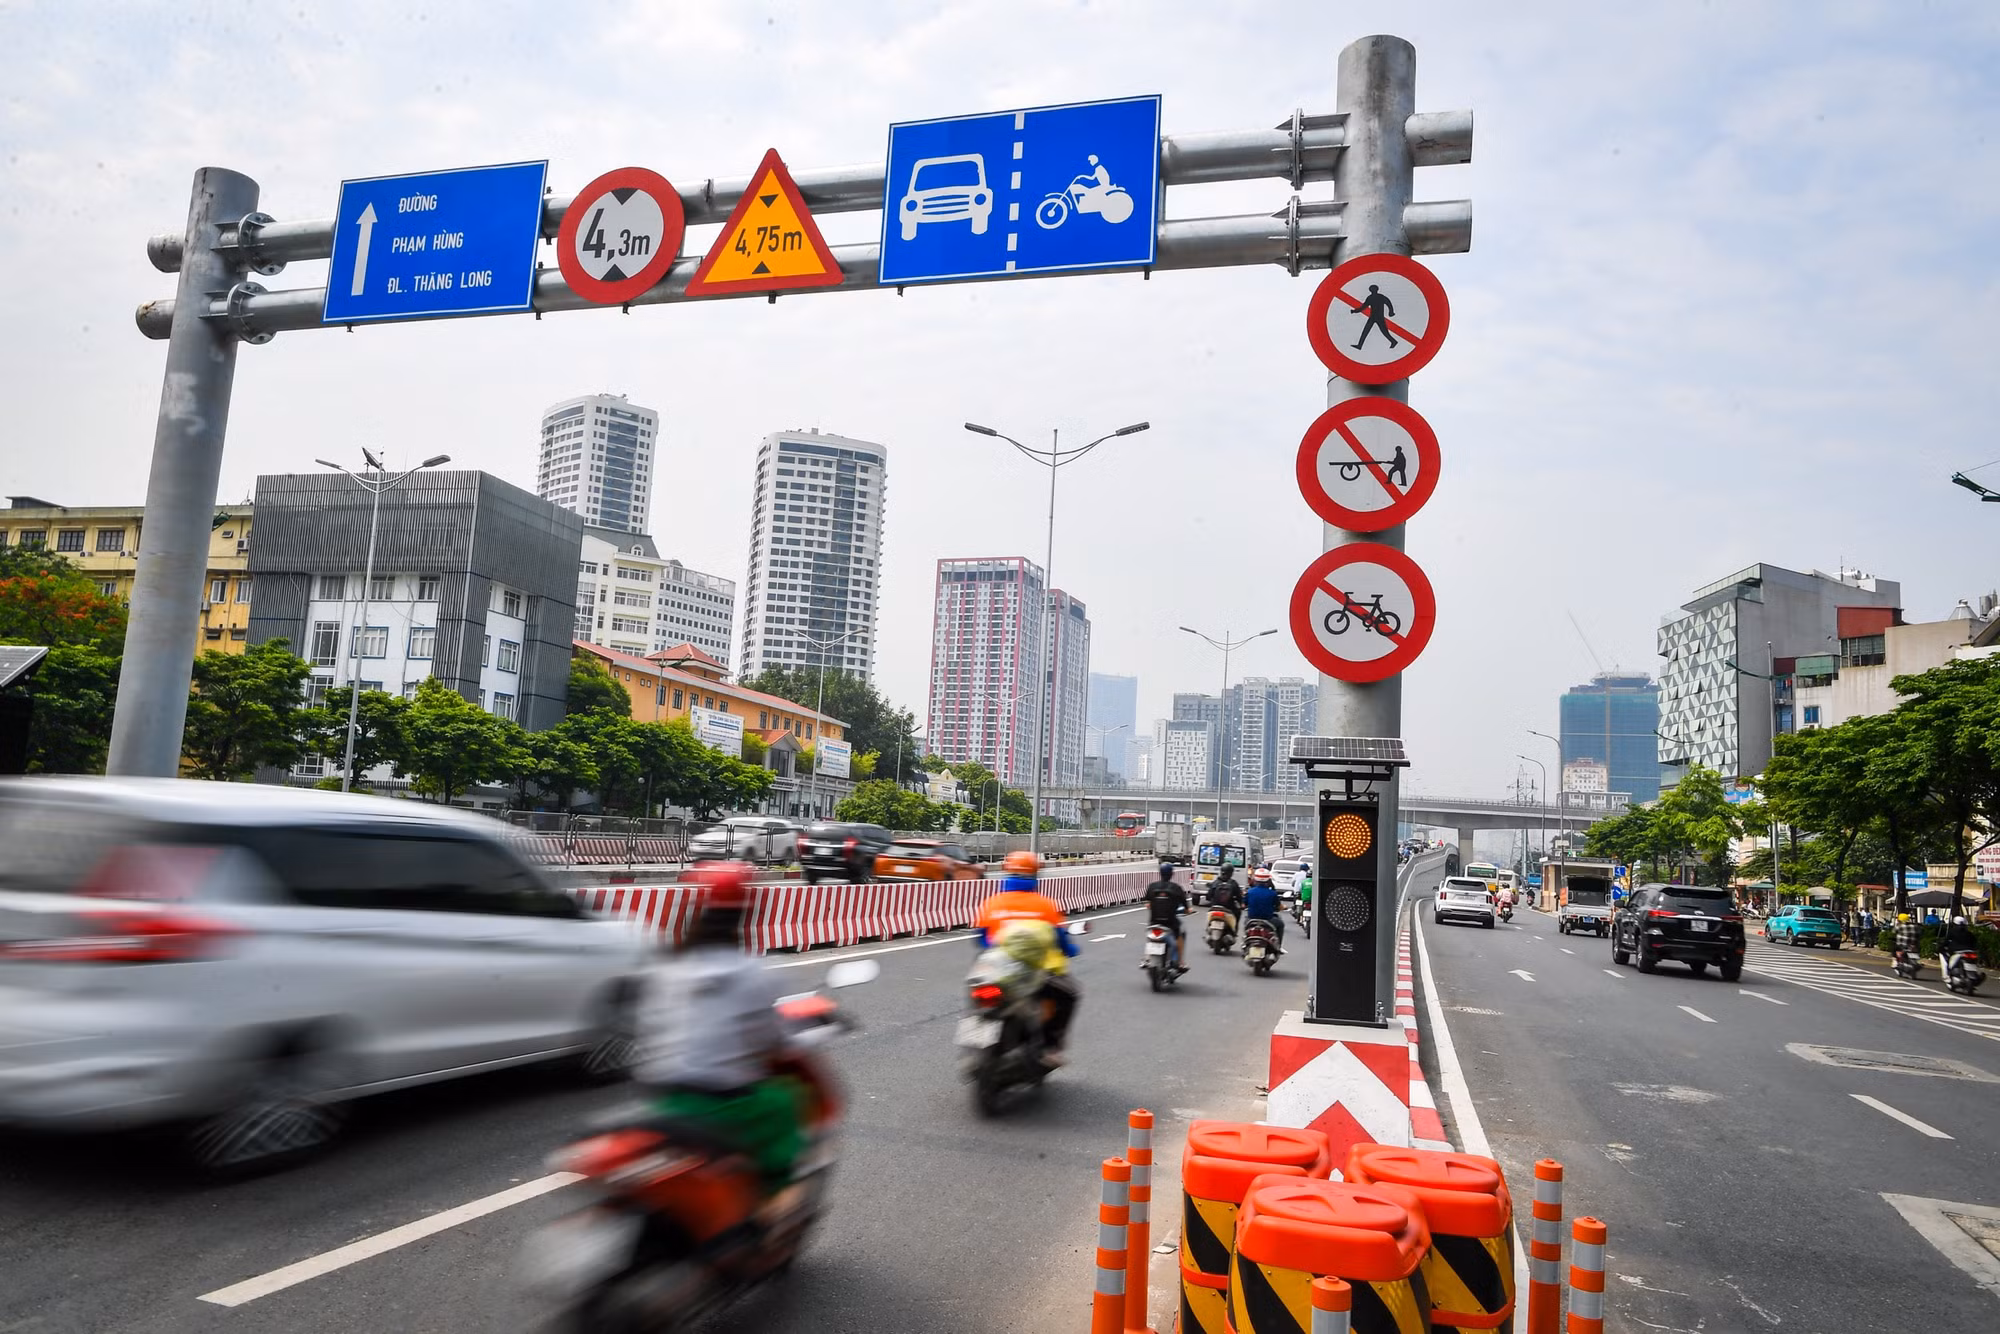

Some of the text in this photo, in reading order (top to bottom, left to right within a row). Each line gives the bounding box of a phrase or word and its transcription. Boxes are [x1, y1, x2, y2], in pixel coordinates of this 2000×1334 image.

[398, 192, 438, 214] ĐƯỜNG
[391, 229, 464, 256] PHẠM HÙNG
[582, 208, 651, 263] 4,3m
[387, 277, 408, 294] ĐL.
[460, 270, 493, 289] LONG
